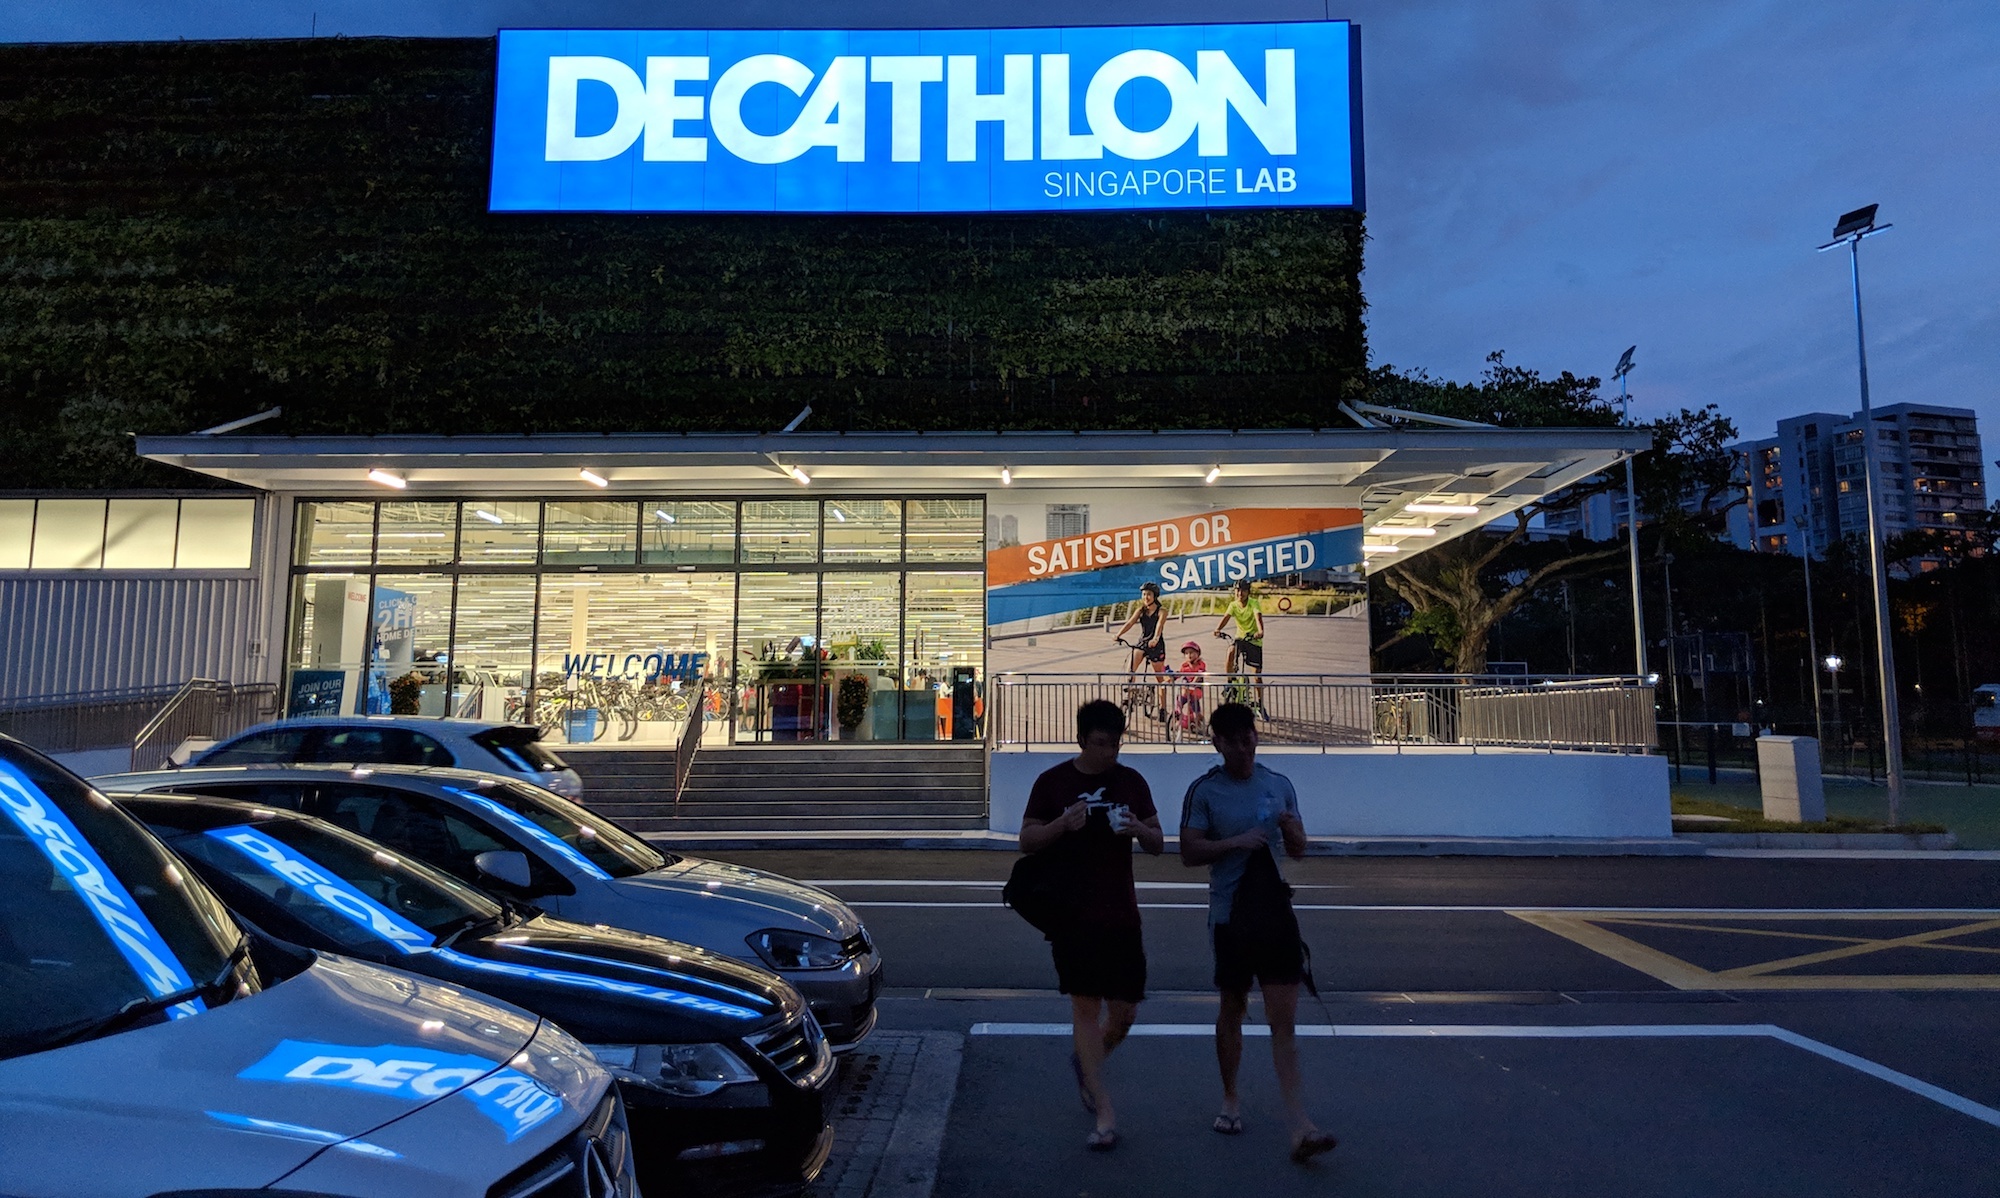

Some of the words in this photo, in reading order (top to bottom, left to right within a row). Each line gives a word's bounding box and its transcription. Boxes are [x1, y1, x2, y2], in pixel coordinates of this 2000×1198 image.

[546, 49, 1297, 164] DECATHLON
[1044, 168, 1226, 198] SINGAPORE
[1236, 168, 1297, 193] LAB
[1028, 524, 1180, 575] SATISFIED
[1189, 514, 1231, 547] OR
[1160, 539, 1315, 592] SATISFIED
[347, 592, 367, 602] WELCOME
[379, 599, 402, 610] CLICK
[376, 631, 402, 643] HOME
[563, 652, 708, 681] WELCOME
[298, 682, 320, 694] JOIN
[322, 679, 342, 690] OUR
